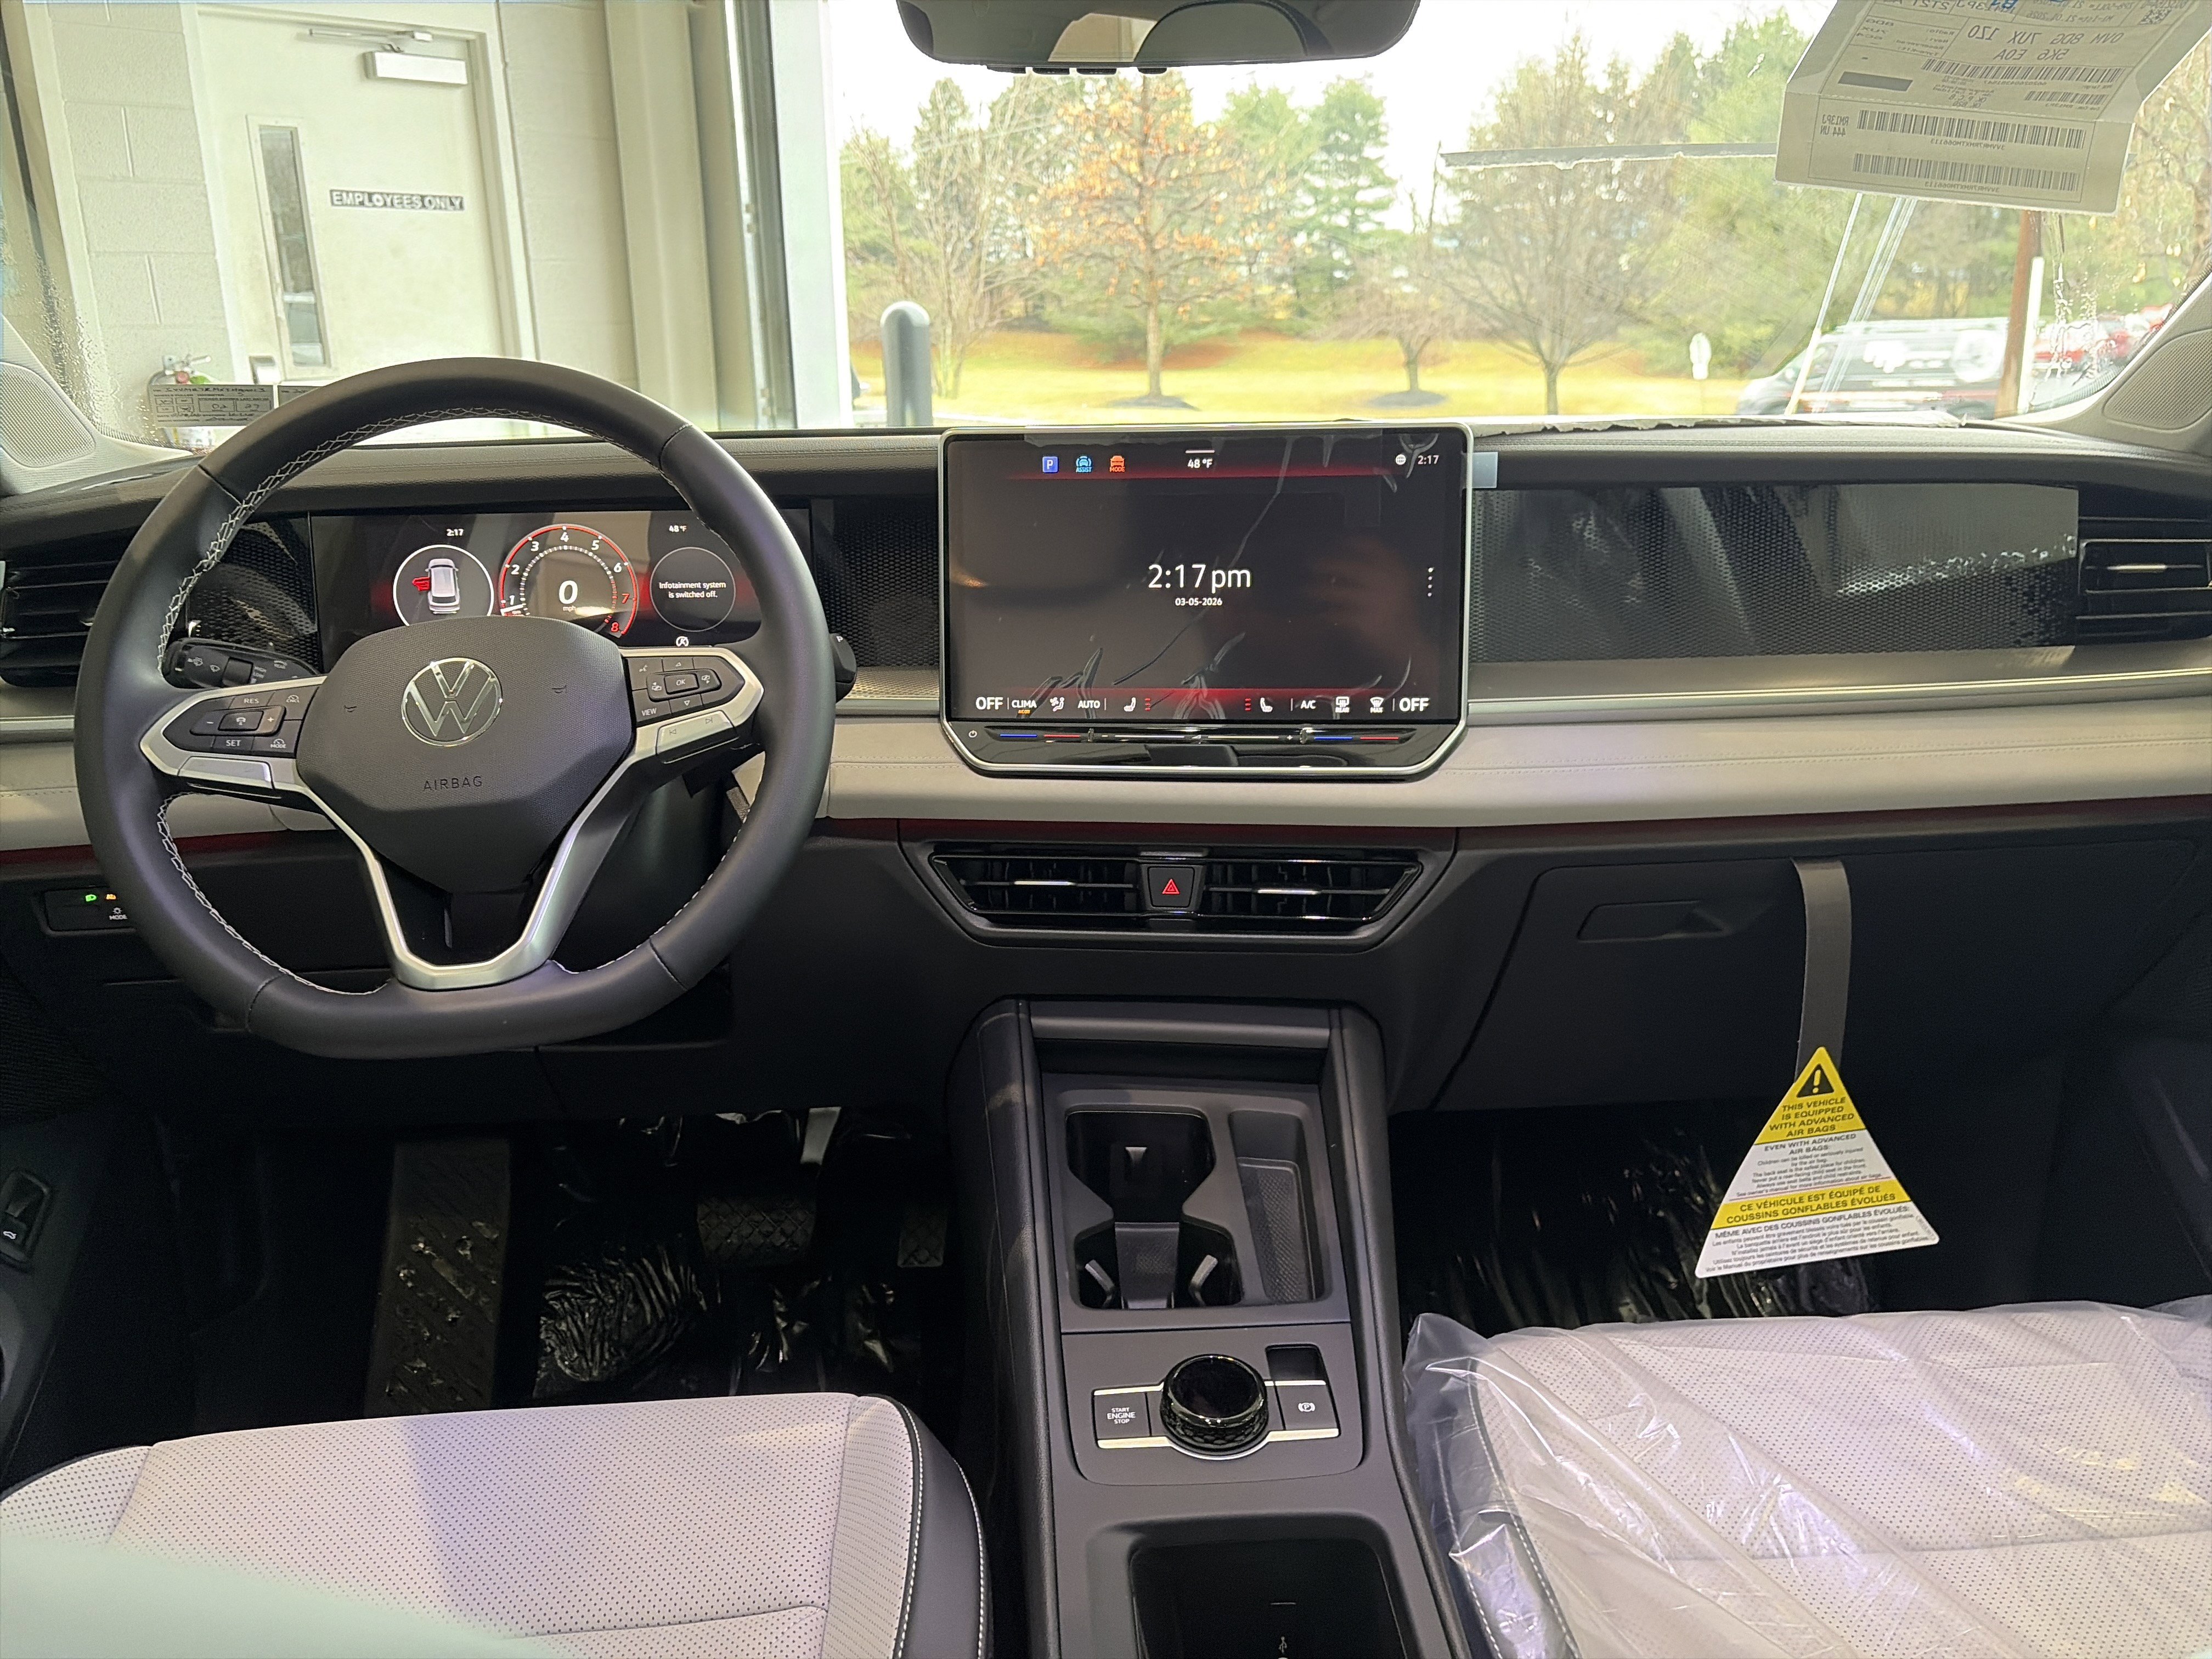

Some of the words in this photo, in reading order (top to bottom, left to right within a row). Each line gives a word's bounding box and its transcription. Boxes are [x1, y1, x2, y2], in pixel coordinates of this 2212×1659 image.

[332, 191, 422, 210] EMPLOYEES
[424, 196, 464, 211] ONLY
[1187, 459, 1200, 469] 48
[1418, 455, 1439, 465] 2:17
[446, 528, 465, 537] 2:17
[560, 532, 569, 542] 4
[531, 541, 540, 551] 3
[591, 540, 600, 550] 5
[511, 563, 520, 574] 2
[613, 562, 623, 573] 6
[1148, 563, 1206, 589] 2:17
[1211, 568, 1252, 593] pm
[659, 581, 701, 589] Infotainment
[702, 583, 727, 591] system
[558, 580, 579, 605] 0
[622, 593, 630, 603] 7
[509, 595, 515, 606] 1
[1175, 597, 1223, 607] 03-05-2026
[610, 622, 619, 633] 8
[975, 697, 1003, 710] OFF
[1011, 699, 1038, 709] CLIMA
[1077, 700, 1101, 709] AUTO
[1300, 700, 1317, 709] A/C
[1399, 697, 1430, 712] OFF
[641, 708, 657, 716] VIEW
[422, 776, 483, 791] AIRBAG
[1782, 1103, 1804, 1111] THIS
[1806, 1097, 1846, 1108] VEHICLE
[1795, 1106, 1844, 1119] EQUIPPED
[1769, 1122, 1796, 1131] WITH
[1798, 1113, 1854, 1127] ADVANCED
[1786, 1130, 1804, 1138] AIR
[1807, 1125, 1836, 1135] BAGS
[1788, 1140, 1810, 1148] WITH
[1812, 1133, 1857, 1145] ADVANCED
[1740, 1203, 1753, 1212] CE
[1754, 1197, 1803, 1210] VÉHICULE
[1807, 1194, 1826, 1205] EST
[1829, 1187, 1864, 1203] ÉQUIPÉ
[1867, 1185, 1881, 1195] DE
[1726, 1209, 1779, 1224] COUSSINS
[1781, 1200, 1848, 1216] GONFLABLES
[1850, 1193, 1895, 1208] ÉVOLUÉS
[1741, 1225, 1762, 1235] AVEC
[1763, 1223, 1780, 1232] DES
[1780, 1217, 1820, 1230] COUSSINS
[1821, 1210, 1872, 1224] GONFLABLES
[1107, 1412, 1136, 1420] ENGINE
